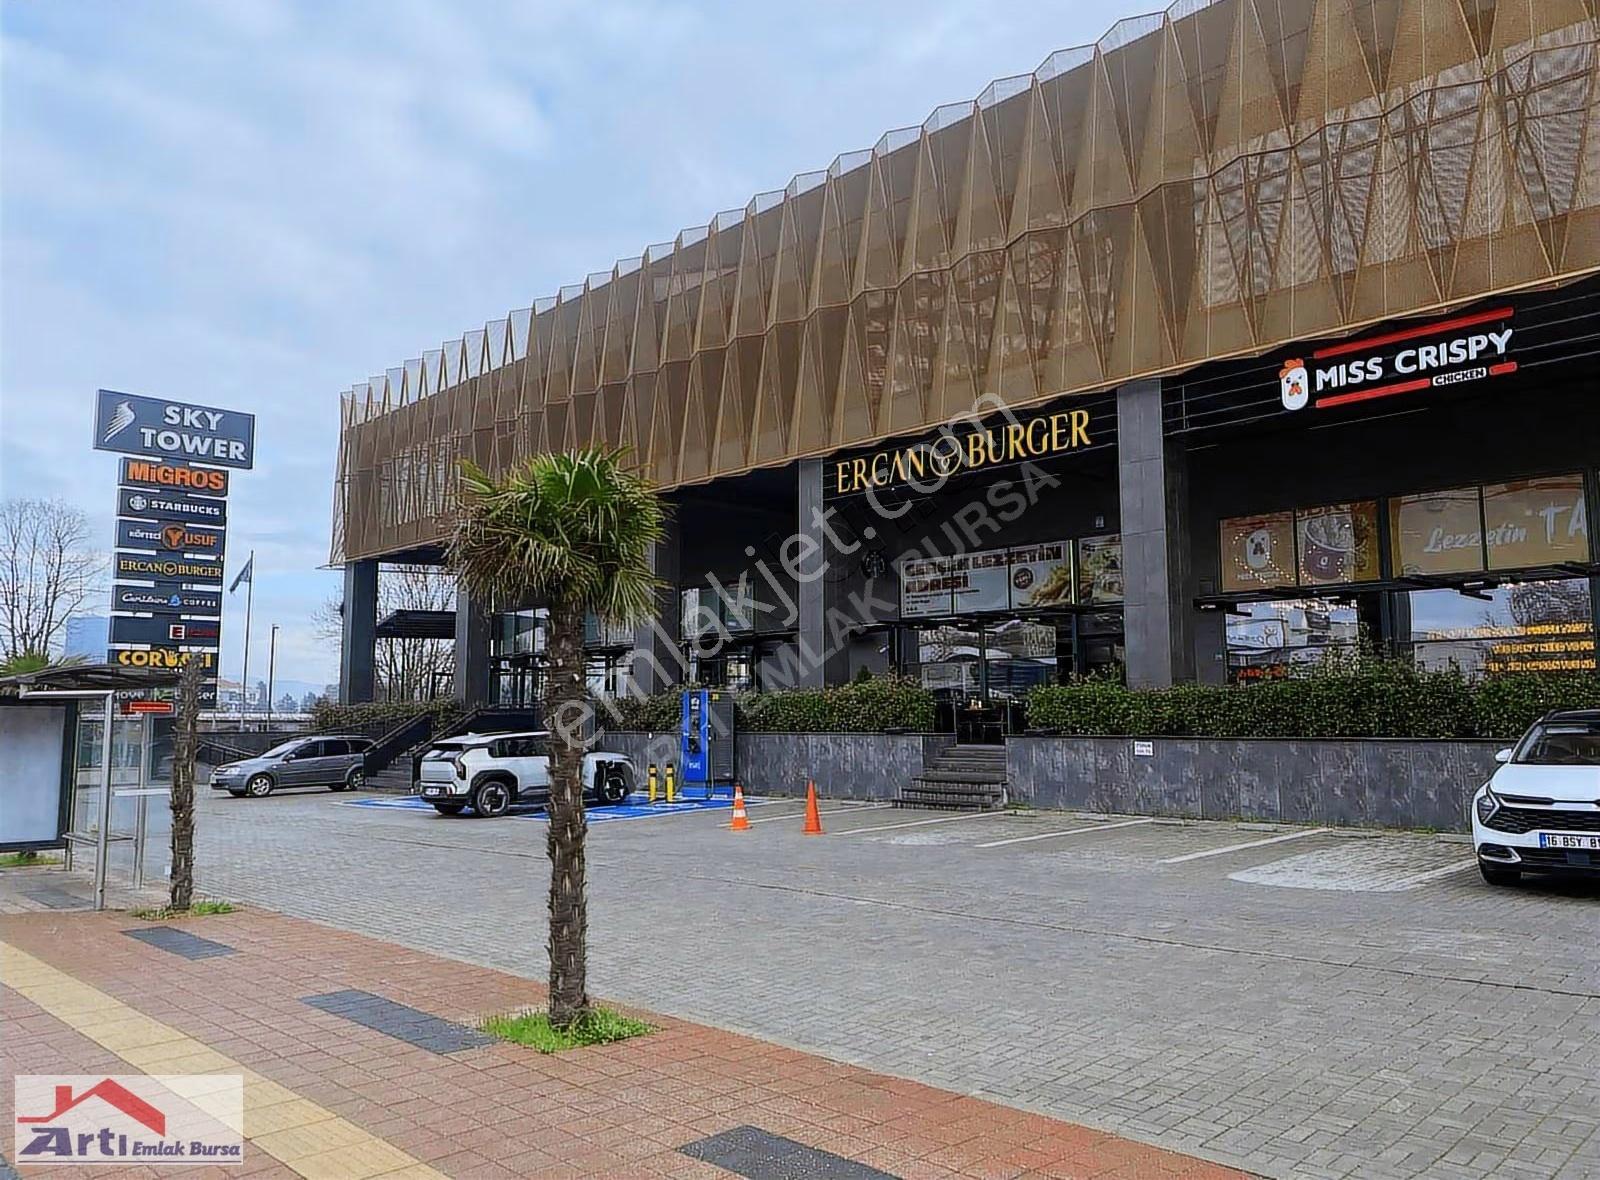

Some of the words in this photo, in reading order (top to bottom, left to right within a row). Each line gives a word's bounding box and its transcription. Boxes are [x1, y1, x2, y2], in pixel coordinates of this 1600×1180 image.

[1316, 357, 1383, 391] MISS
[1395, 329, 1513, 374] CRISPY
[1435, 368, 1485, 386] CHICKEN
[164, 405, 224, 432] SKY
[141, 428, 247, 461] TOWER
[837, 444, 924, 494] ERCAN
[968, 410, 1092, 468] BURGER
[151, 500, 220, 516] STARBUCKS
[1423, 523, 1528, 554] Lezzetin
[120, 560, 163, 573] ERCAN
[178, 564, 222, 578] BURGER
